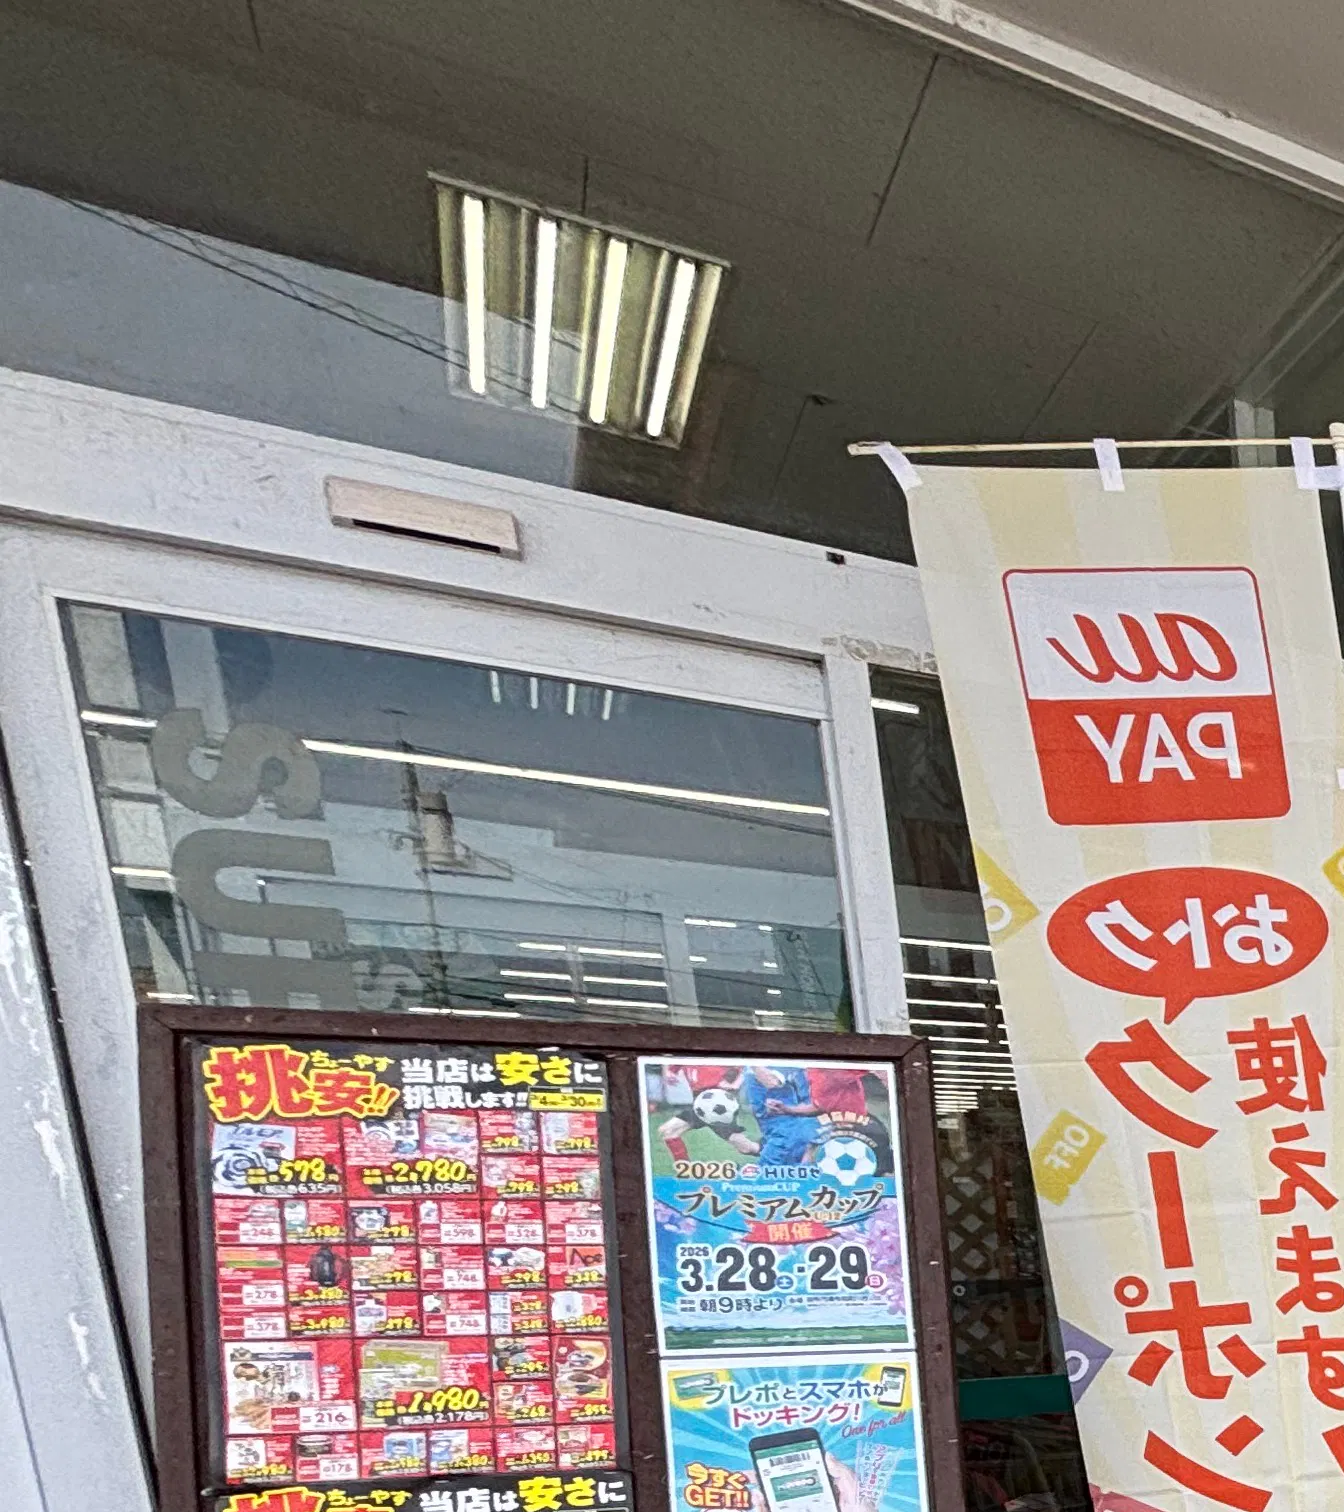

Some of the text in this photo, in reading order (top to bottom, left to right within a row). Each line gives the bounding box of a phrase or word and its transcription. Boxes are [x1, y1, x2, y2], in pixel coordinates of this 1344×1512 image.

[401, 1052, 603, 1086] 当店は安さに
[402, 1085, 528, 1110] 挑戦します!!
[674, 1161, 736, 1181] 2026
[676, 1182, 884, 1222] プレミアムカップ
[767, 1221, 813, 1242] 開催
[680, 1246, 710, 1257] 2026
[699, 1296, 783, 1314] 朝9時より
[408, 1387, 480, 1413] 1,980
[703, 1380, 889, 1406] プレポとスマホが
[314, 1412, 347, 1425] 216
[731, 1403, 862, 1428] ドッキング!
[686, 1462, 751, 1490] 今すぐ
[684, 1484, 751, 1509] GET!!
